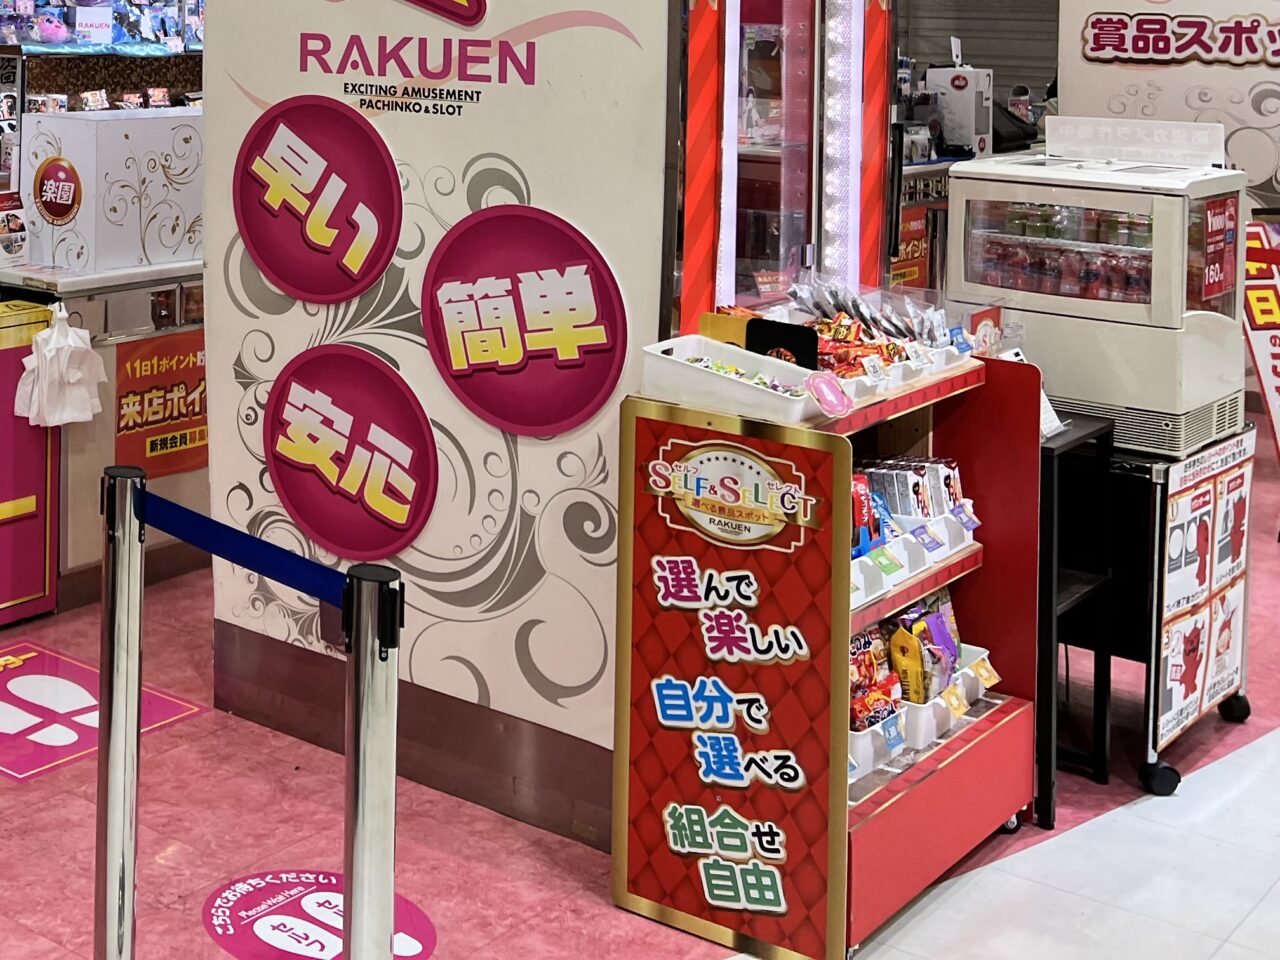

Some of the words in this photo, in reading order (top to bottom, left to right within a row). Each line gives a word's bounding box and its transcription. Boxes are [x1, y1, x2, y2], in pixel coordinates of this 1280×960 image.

[1, 57, 17, 84] 次回
[299, 32, 536, 86] RAKUEN
[343, 83, 398, 98] EXCITING
[401, 86, 482, 102] AMUSEMENT
[42, 179, 75, 204] 楽園
[251, 121, 381, 276] 早い
[436, 263, 608, 371] 簡単
[120, 380, 207, 428] 来店ポイ
[274, 380, 417, 526] 安心
[674, 464, 699, 475] セルフ
[767, 481, 799, 494] セレクト
[709, 518, 751, 534] RAKUEN
[657, 559, 754, 603] 選んで
[704, 611, 803, 656] 楽しい
[656, 679, 764, 724] 自分で
[697, 735, 799, 782] 選べる
[669, 806, 780, 854] 組合せ
[211, 872, 337, 935] こちらでお待ちください
[238, 901, 266, 920] Please
[264, 892, 286, 910] Wait
[284, 885, 305, 900] Here
[704, 859, 782, 908] 自由
